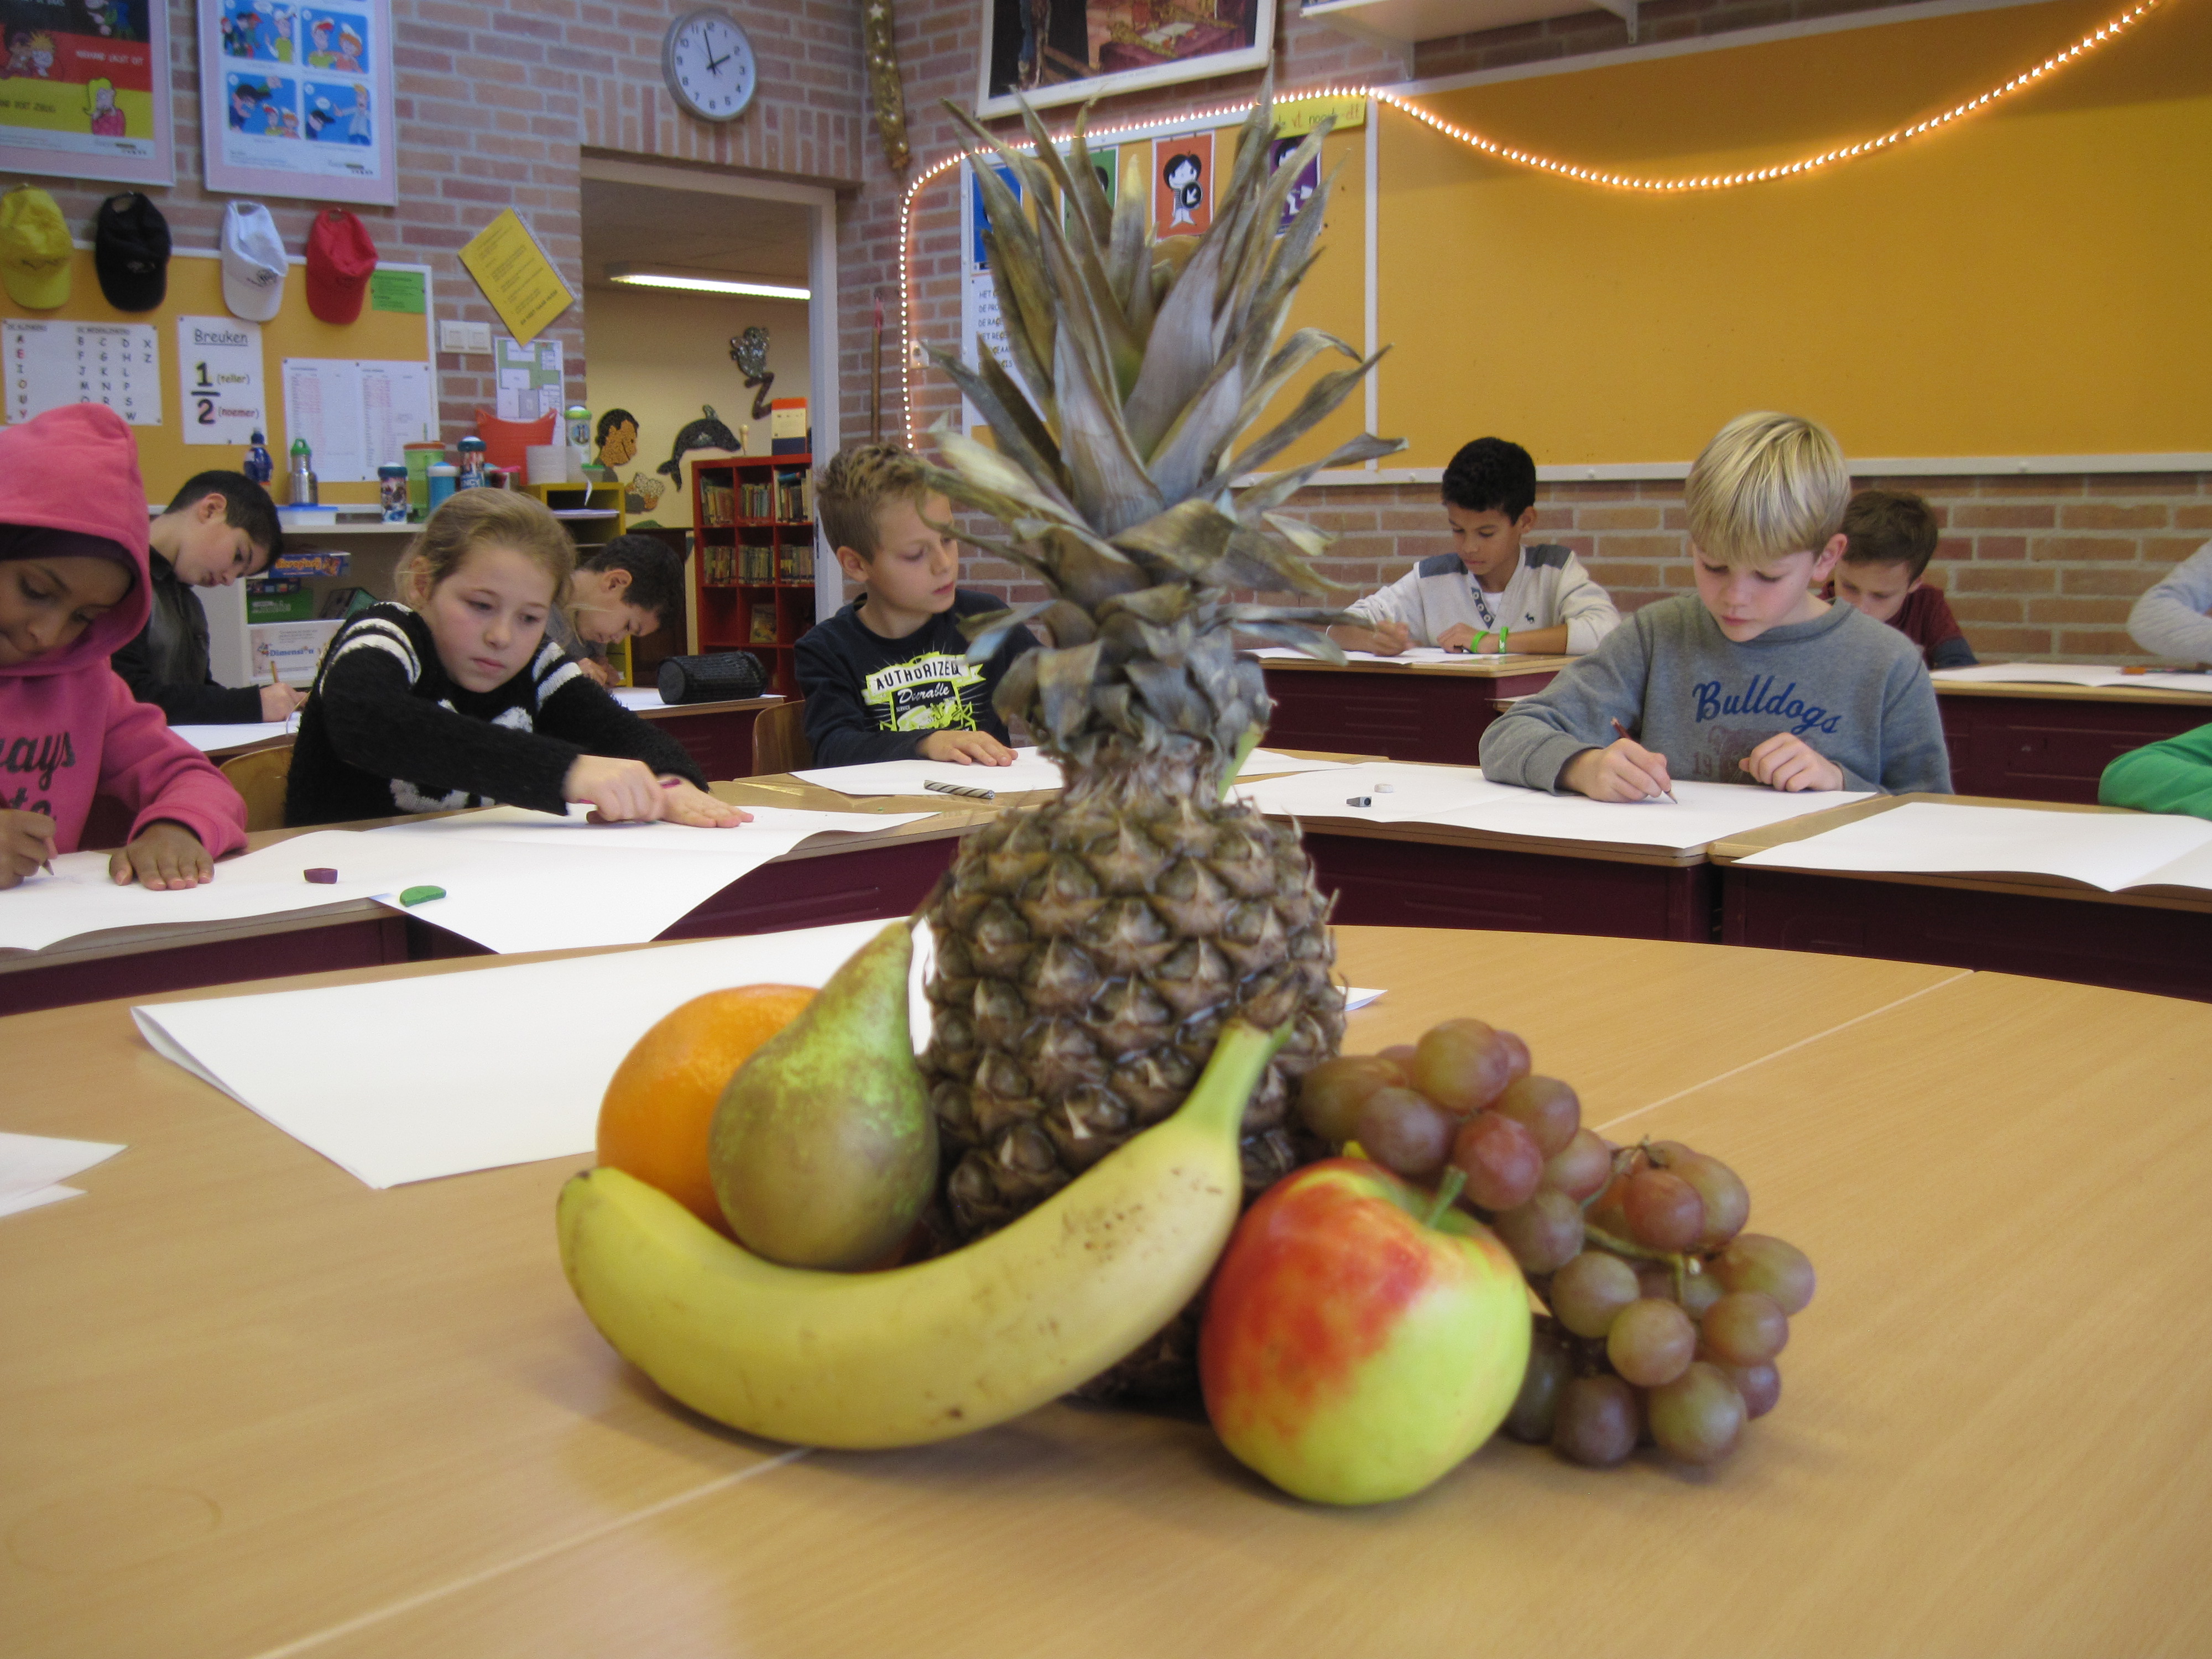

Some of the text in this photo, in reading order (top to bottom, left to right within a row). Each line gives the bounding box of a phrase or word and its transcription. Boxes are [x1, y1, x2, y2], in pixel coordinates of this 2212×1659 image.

[681, 38, 690, 48] 10
[734, 46, 740, 55] 2
[676, 56, 682, 66] 9
[739, 66, 745, 75] 3
[736, 84, 742, 93] 4
[694, 92, 700, 101] 7
[17, 335, 24, 343] A
[78, 336, 152, 348] B C D X
[195, 328, 248, 347] Breuken
[17, 349, 24, 358] E
[79, 351, 84, 359] F
[123, 353, 131, 362] H
[145, 353, 152, 363] Z
[17, 363, 23, 373] I
[79, 366, 129, 377] J K L
[196, 361, 250, 387] 1 (teller)
[18, 379, 27, 389] O
[81, 381, 131, 390] M N P
[126, 398, 133, 406] S
[127, 412, 136, 420] W
[197, 398, 259, 424] 2 (noemer)
[897, 682, 950, 704] Durable
[1692, 674, 1841, 735] Bulldogs
